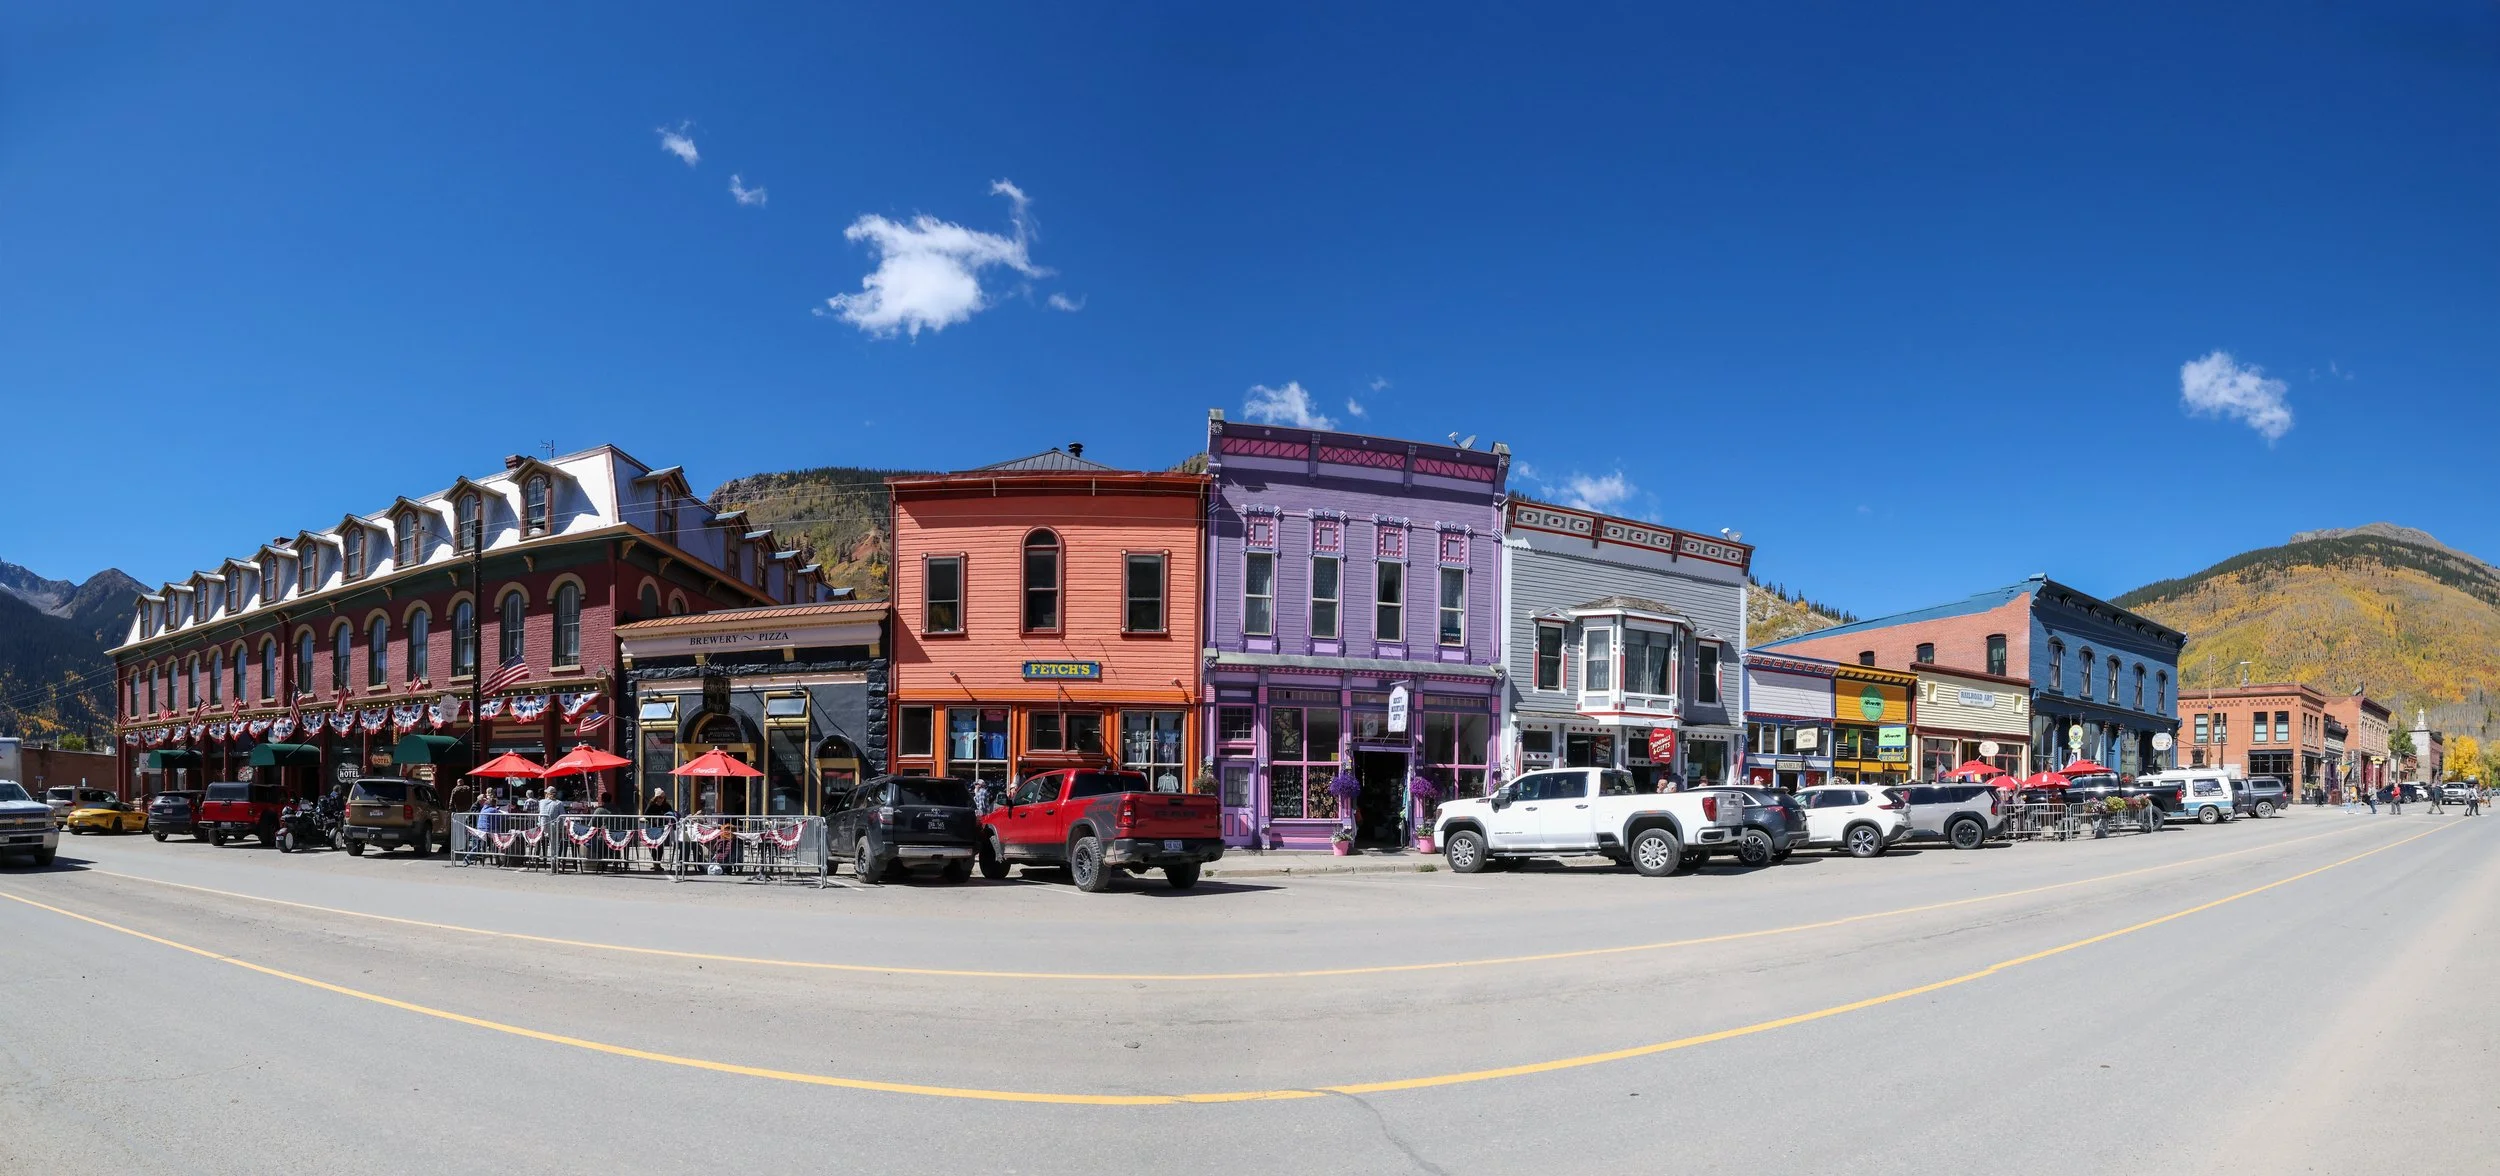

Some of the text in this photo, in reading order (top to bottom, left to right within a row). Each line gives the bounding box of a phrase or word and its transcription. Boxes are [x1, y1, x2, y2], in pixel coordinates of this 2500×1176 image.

[690, 631, 789, 646] BREWERY PIZZA
[1031, 663, 1091, 675] FETCH'S
[1960, 691, 1993, 702] RAILROAD ART
[339, 769, 360, 779] HOTEL
